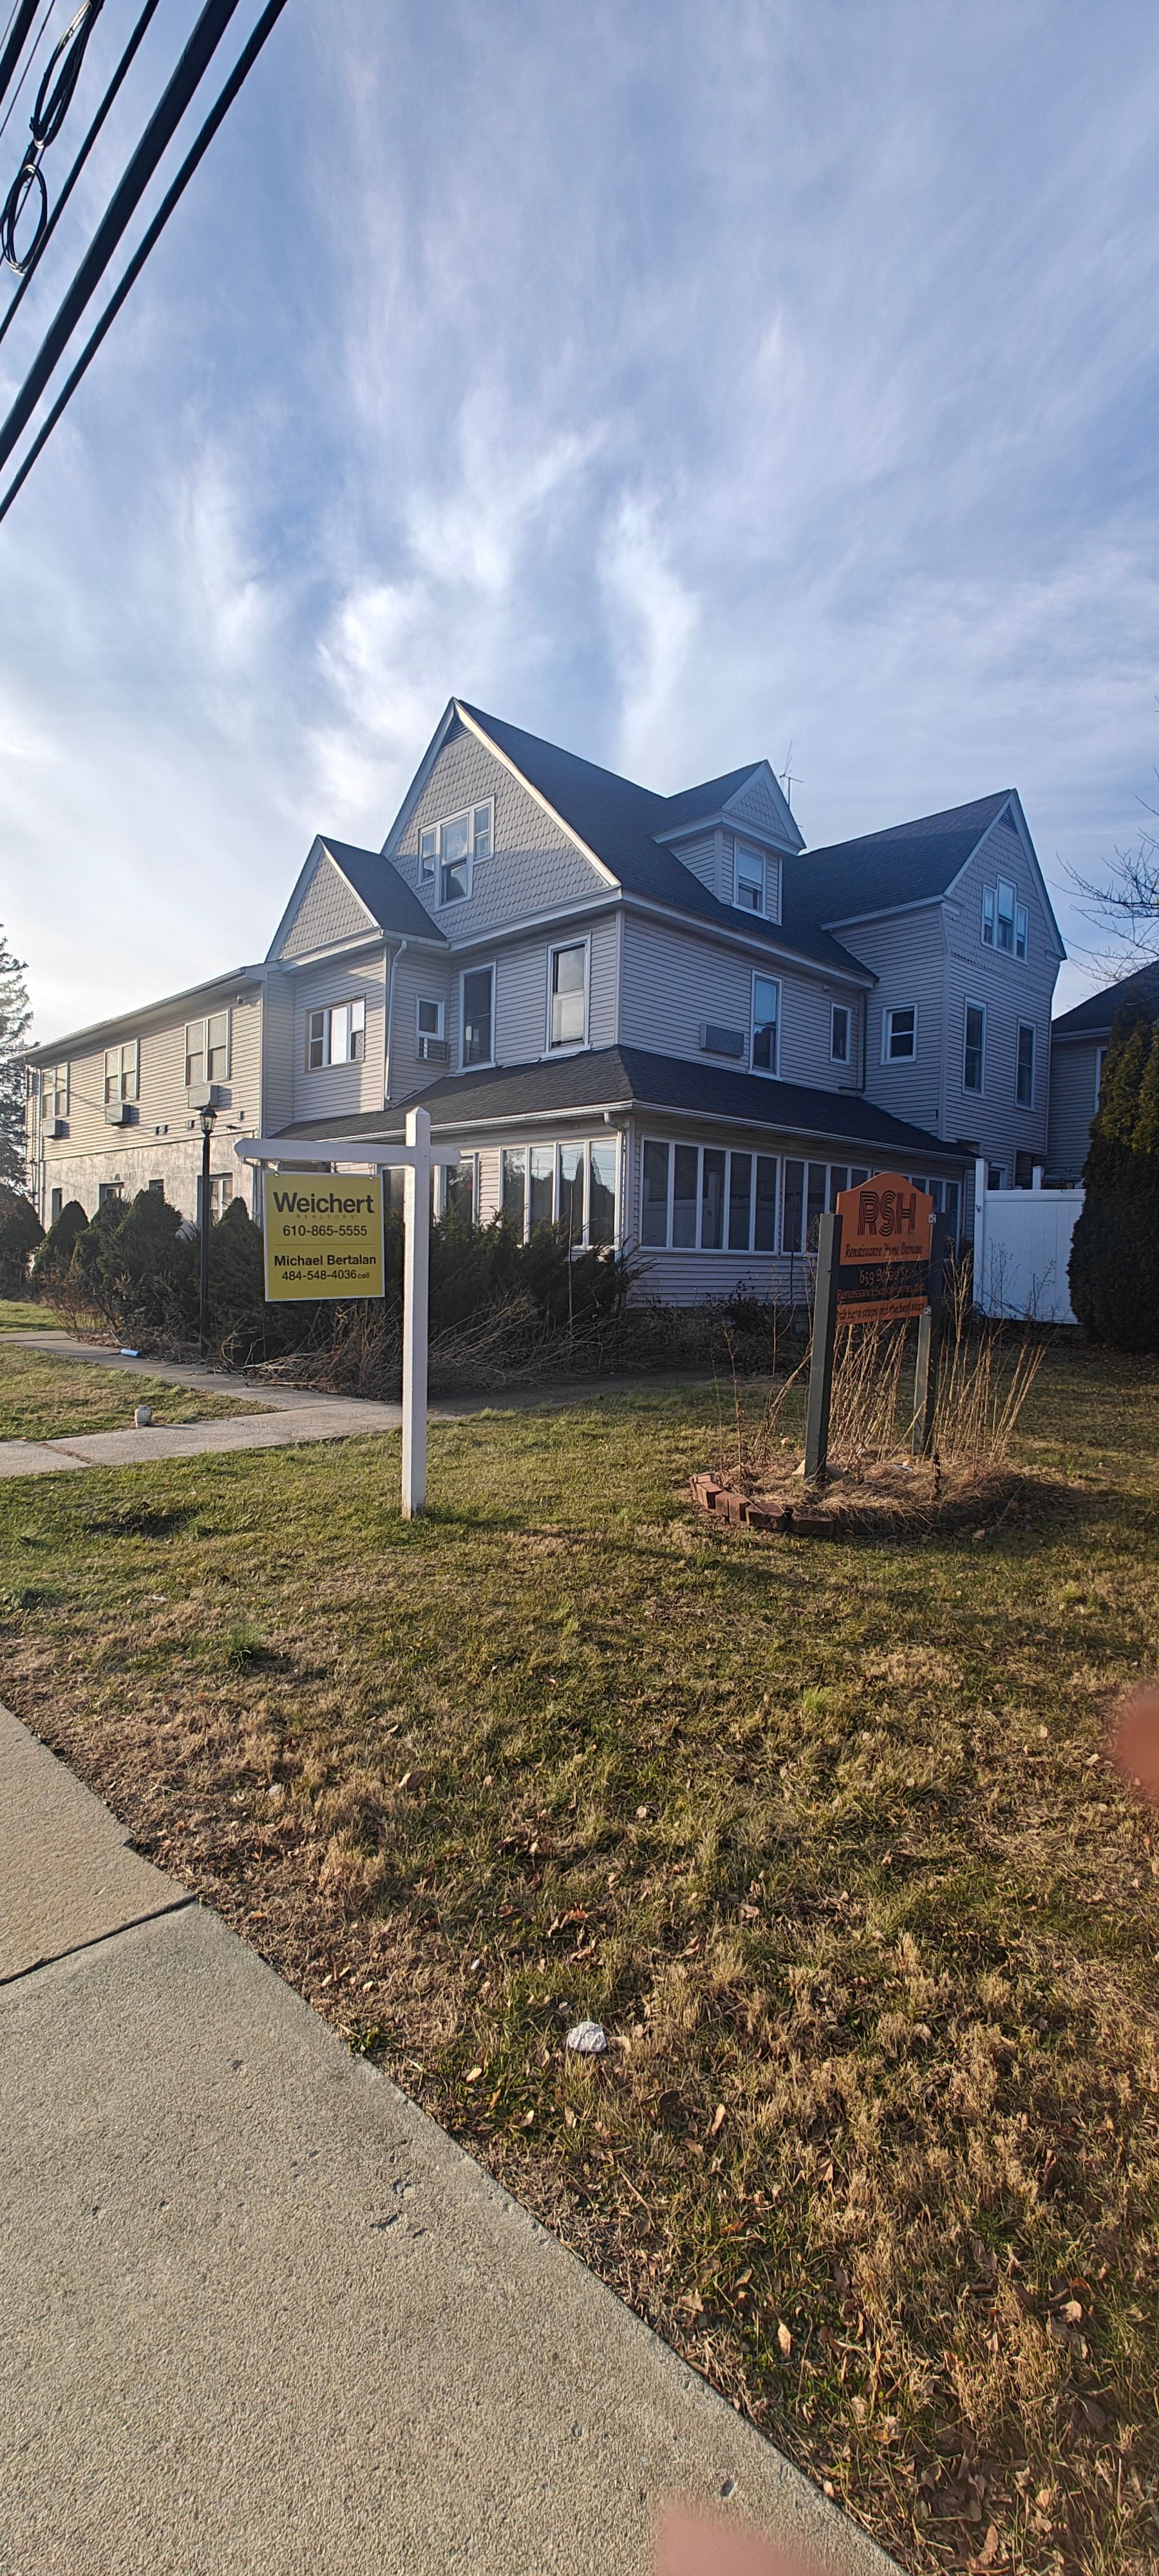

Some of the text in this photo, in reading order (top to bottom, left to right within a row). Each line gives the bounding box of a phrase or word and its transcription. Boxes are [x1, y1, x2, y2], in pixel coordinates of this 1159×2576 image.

[273, 1191, 375, 1213] Weichert
[858, 1190, 916, 1236] RSH
[283, 1225, 367, 1236] 610-865-5555
[844, 1244, 882, 1258] Renaissance
[274, 1255, 376, 1267] Michael Bertalan
[281, 1269, 357, 1281] 484-548-4036
[859, 1269, 874, 1286] 659
